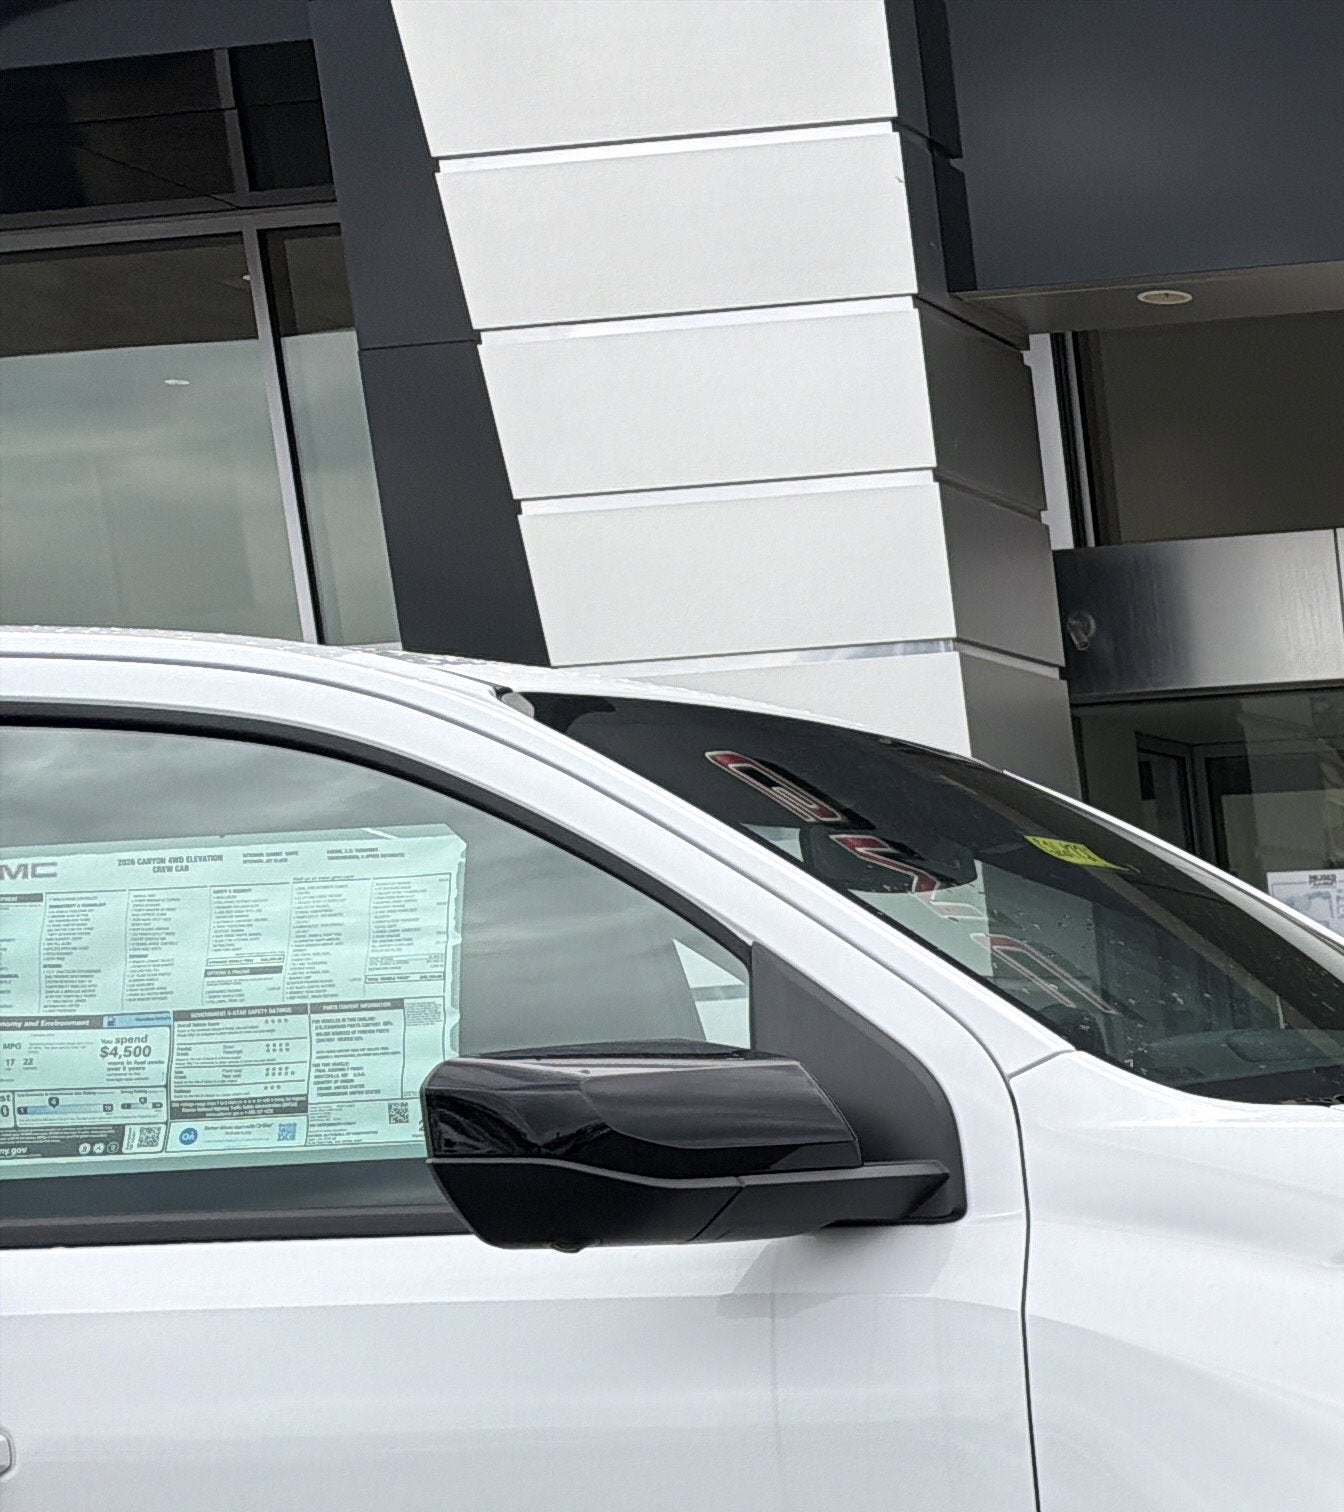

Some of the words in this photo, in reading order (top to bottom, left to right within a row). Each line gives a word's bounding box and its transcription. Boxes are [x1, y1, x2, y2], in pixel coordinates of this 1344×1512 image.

[137, 857, 166, 866] CANYON
[168, 855, 184, 864] 4WD
[186, 854, 223, 864] ELEVATION
[152, 865, 173, 873] CREW
[175, 864, 189, 872] CAB
[24, 1019, 39, 1027] and
[40, 1019, 90, 1027] Environment
[115, 1034, 148, 1046] spend
[3, 1042, 22, 1050] MPG
[99, 1045, 152, 1060] $4,500
[6, 1058, 15, 1067] 17
[23, 1058, 34, 1066] 22
